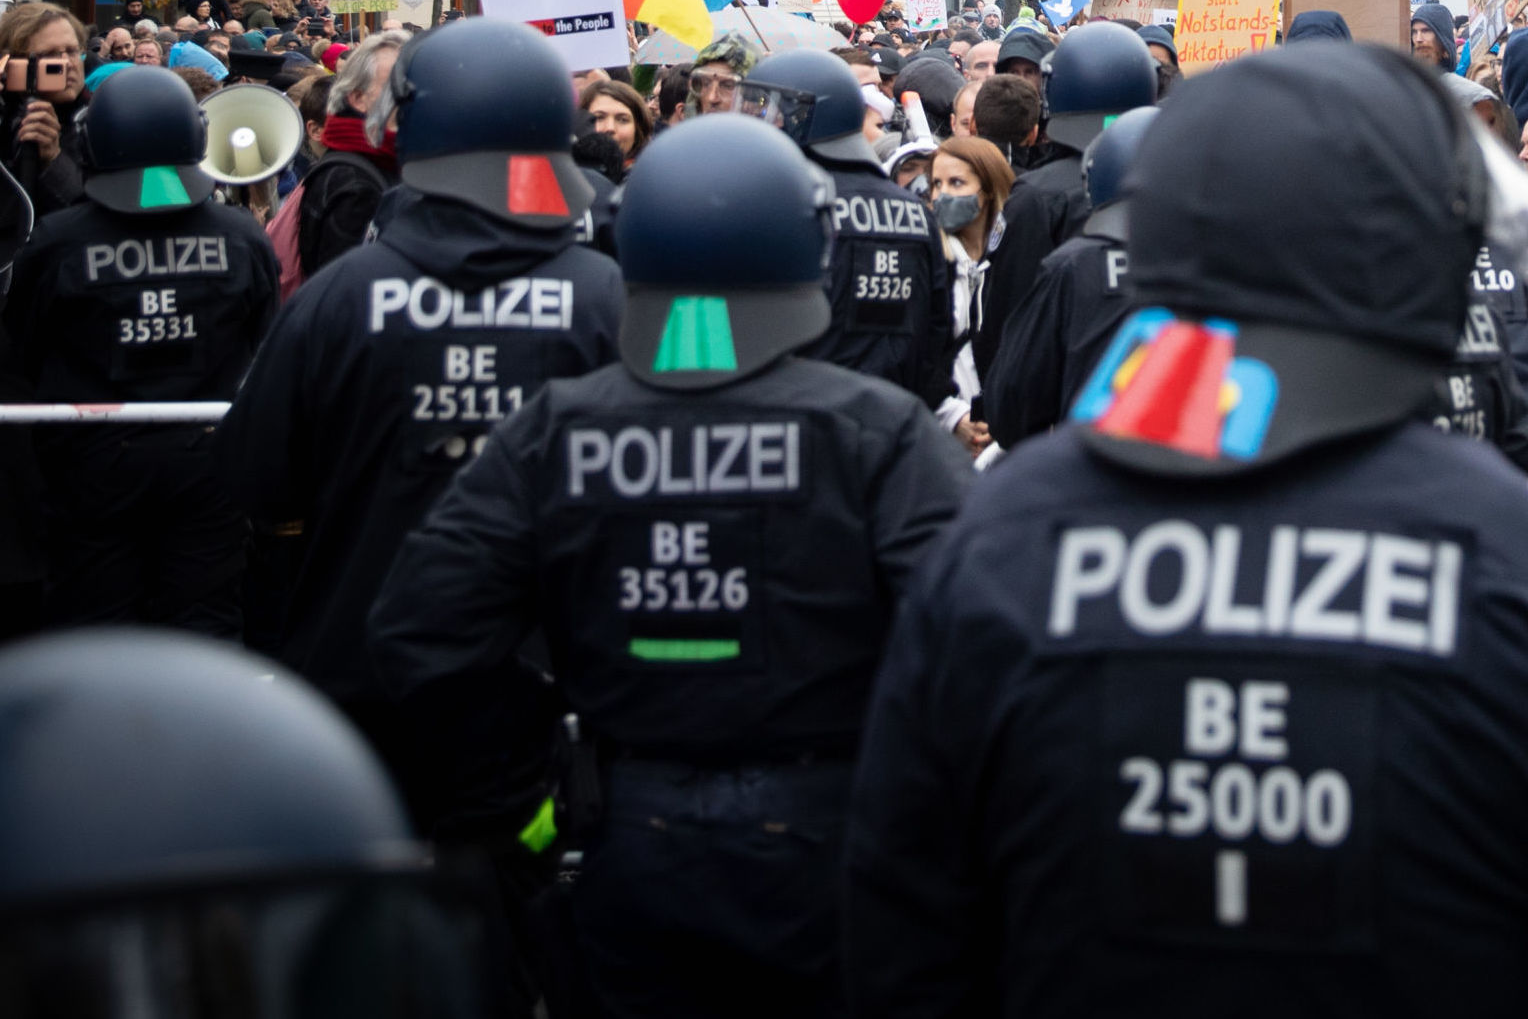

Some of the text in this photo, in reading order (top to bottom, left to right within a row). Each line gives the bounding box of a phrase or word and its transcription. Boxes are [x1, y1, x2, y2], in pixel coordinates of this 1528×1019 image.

[555, 21, 573, 33] the
[575, 15, 609, 31] People
[832, 196, 930, 235] POLIZEI
[87, 236, 229, 281] POLIZEI
[875, 251, 900, 274] BE
[142, 290, 177, 315] BE
[371, 277, 573, 332] POLIZEI
[856, 276, 912, 299] 35326
[120, 315, 197, 343] 35331
[445, 345, 497, 382] BE
[413, 386, 523, 420] 25111
[568, 422, 800, 496] POLIZEI
[652, 522, 710, 564] BE
[619, 568, 749, 610] 35126
[1049, 521, 1462, 655] POLIZEI
[1186, 680, 1289, 759] BE
[1120, 758, 1351, 846] 25000
